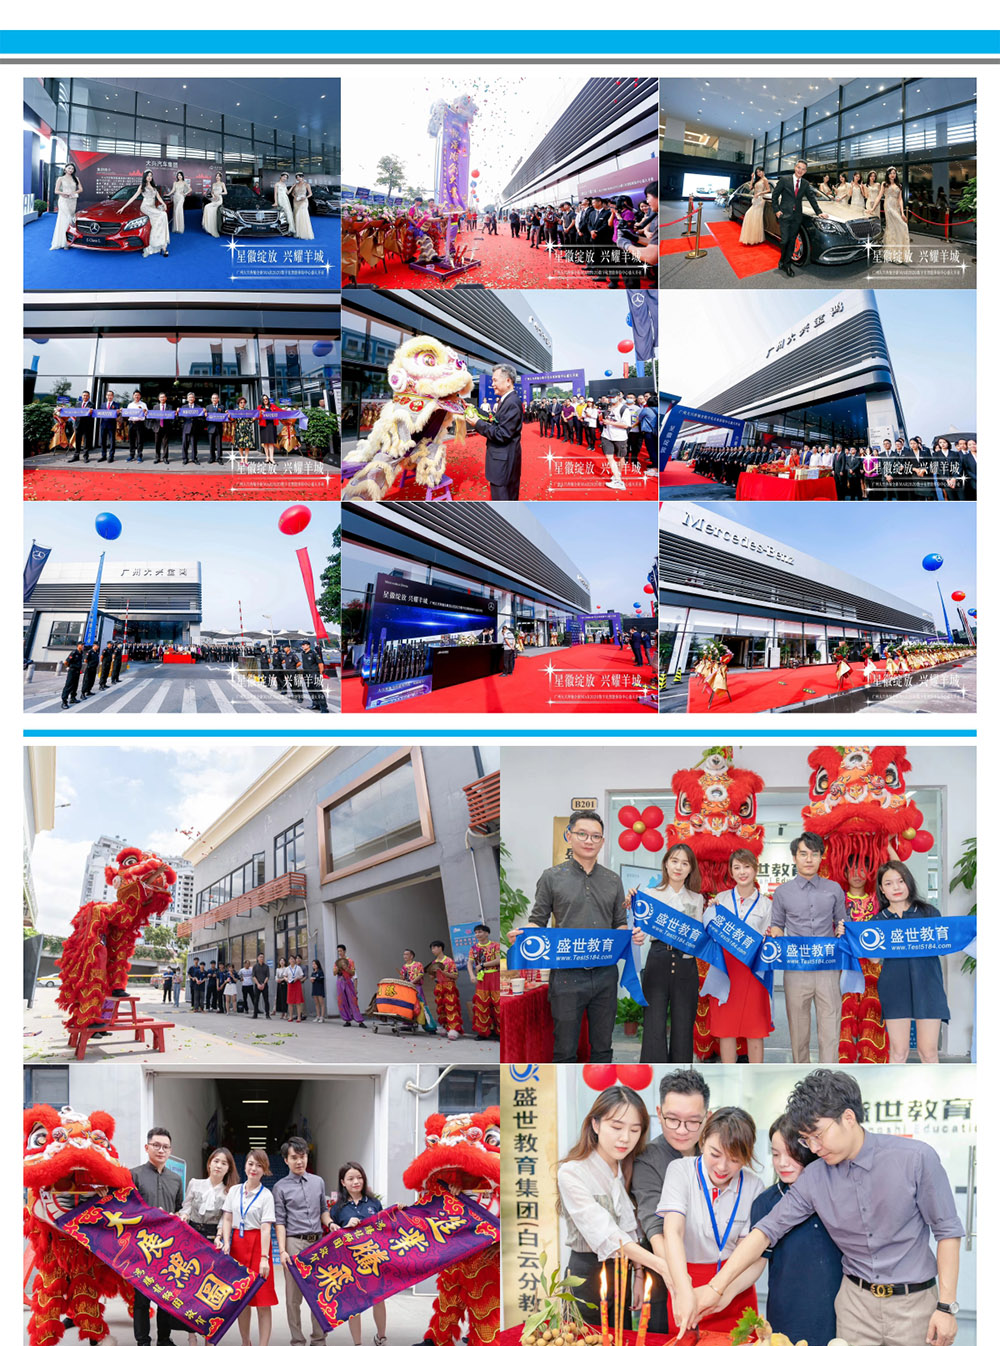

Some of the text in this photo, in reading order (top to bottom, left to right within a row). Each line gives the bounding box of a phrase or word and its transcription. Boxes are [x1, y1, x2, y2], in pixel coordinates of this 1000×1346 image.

[682, 511, 795, 566] Mercedes-Benz
[654, 912, 702, 942] 盛世教育
[712, 914, 756, 949] 盛世教育
[891, 925, 949, 943] 盛世教育
[556, 938, 614, 954] 盛世教育
[786, 943, 836, 958] 盛世教育
